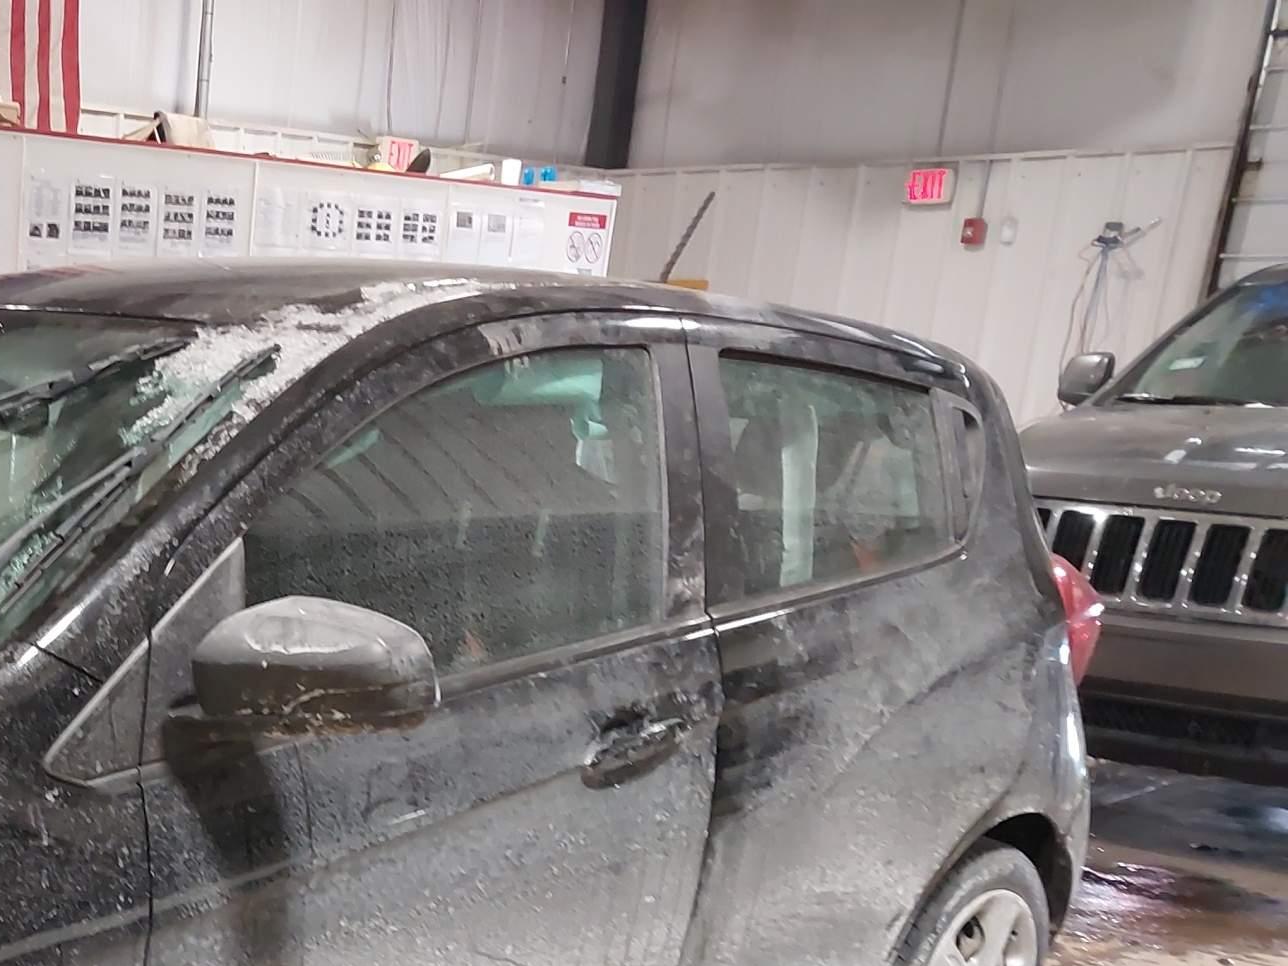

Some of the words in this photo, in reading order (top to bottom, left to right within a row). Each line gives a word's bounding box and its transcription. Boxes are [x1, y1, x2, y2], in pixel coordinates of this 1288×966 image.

[387, 140, 414, 169] EXIT
[908, 169, 946, 200] EXIT
[1153, 484, 1223, 505] Jeep
